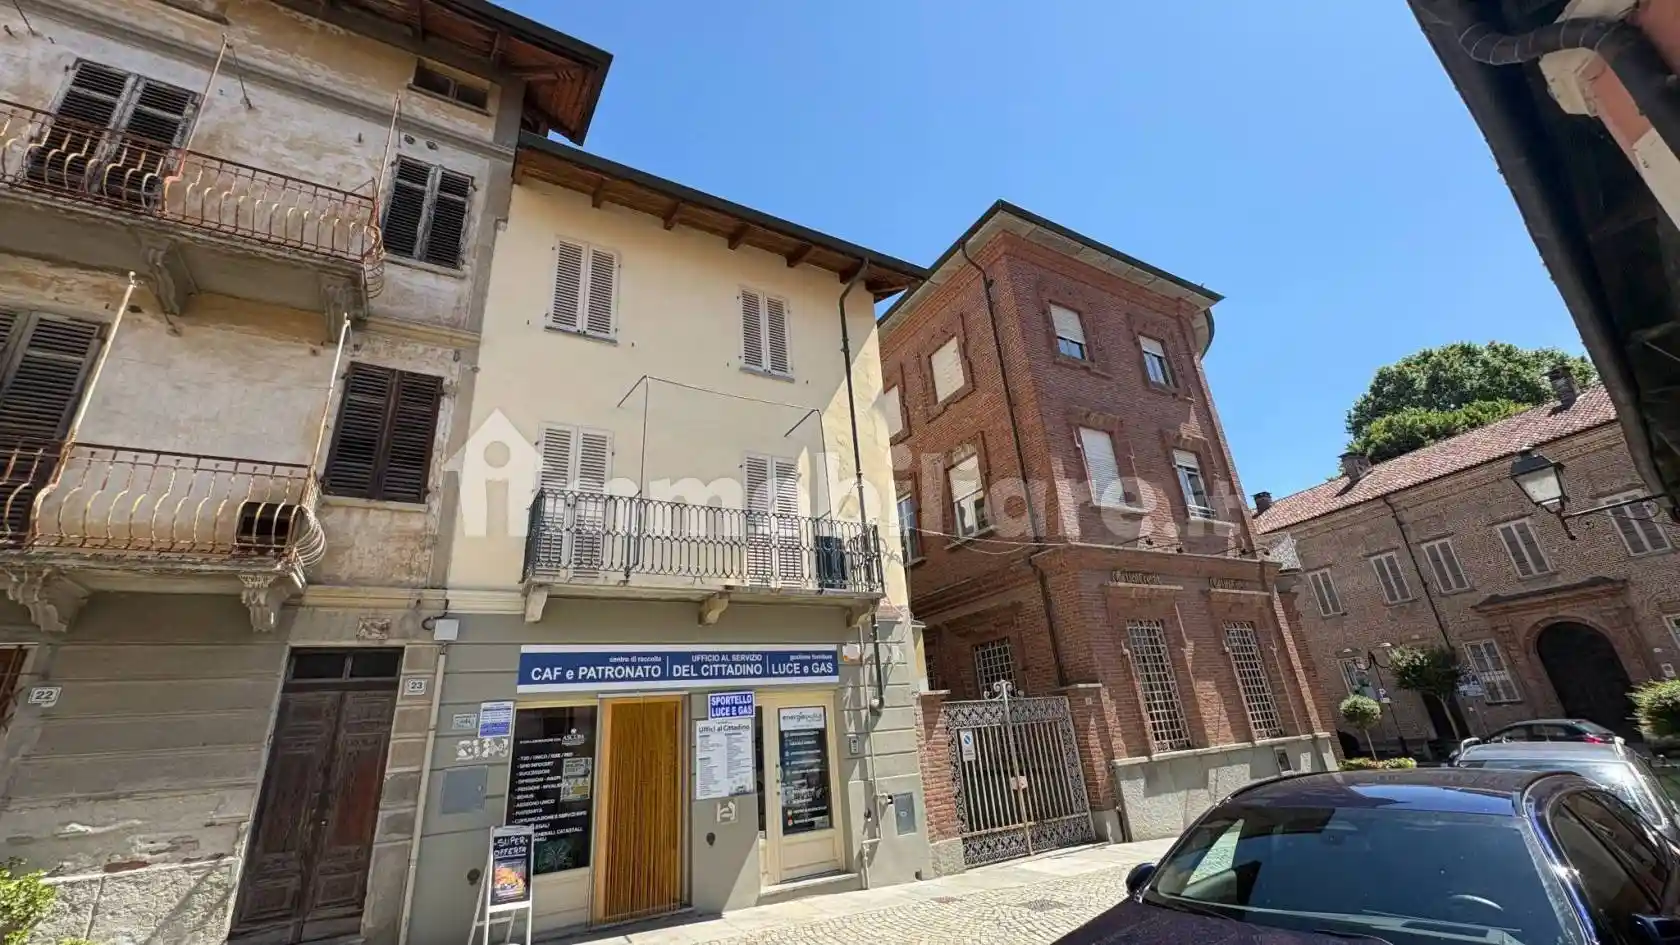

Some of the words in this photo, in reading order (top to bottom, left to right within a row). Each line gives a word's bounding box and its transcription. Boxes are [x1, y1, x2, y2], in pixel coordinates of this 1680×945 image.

[631, 655, 637, 663] di
[692, 654, 720, 662] UFFICIO
[721, 654, 730, 662] AL
[731, 653, 763, 661] SERVIZIO
[531, 666, 563, 681] CAF
[565, 669, 575, 680] e
[578, 665, 662, 680] PATRONATO
[672, 664, 698, 677] DEL
[700, 663, 763, 677] CITTADINO
[771, 663, 801, 675] LUCE
[803, 665, 809, 674] e
[811, 662, 833, 674] GAS
[36, 690, 53, 699] 22
[711, 694, 752, 706] SPORTELLO
[711, 706, 731, 717] LUCE
[731, 706, 737, 716] E
[738, 704, 753, 715] GAS
[723, 723, 750, 732] Cittadino
[498, 835, 525, 847] SUPER
[494, 846, 527, 856] OFFERTA
